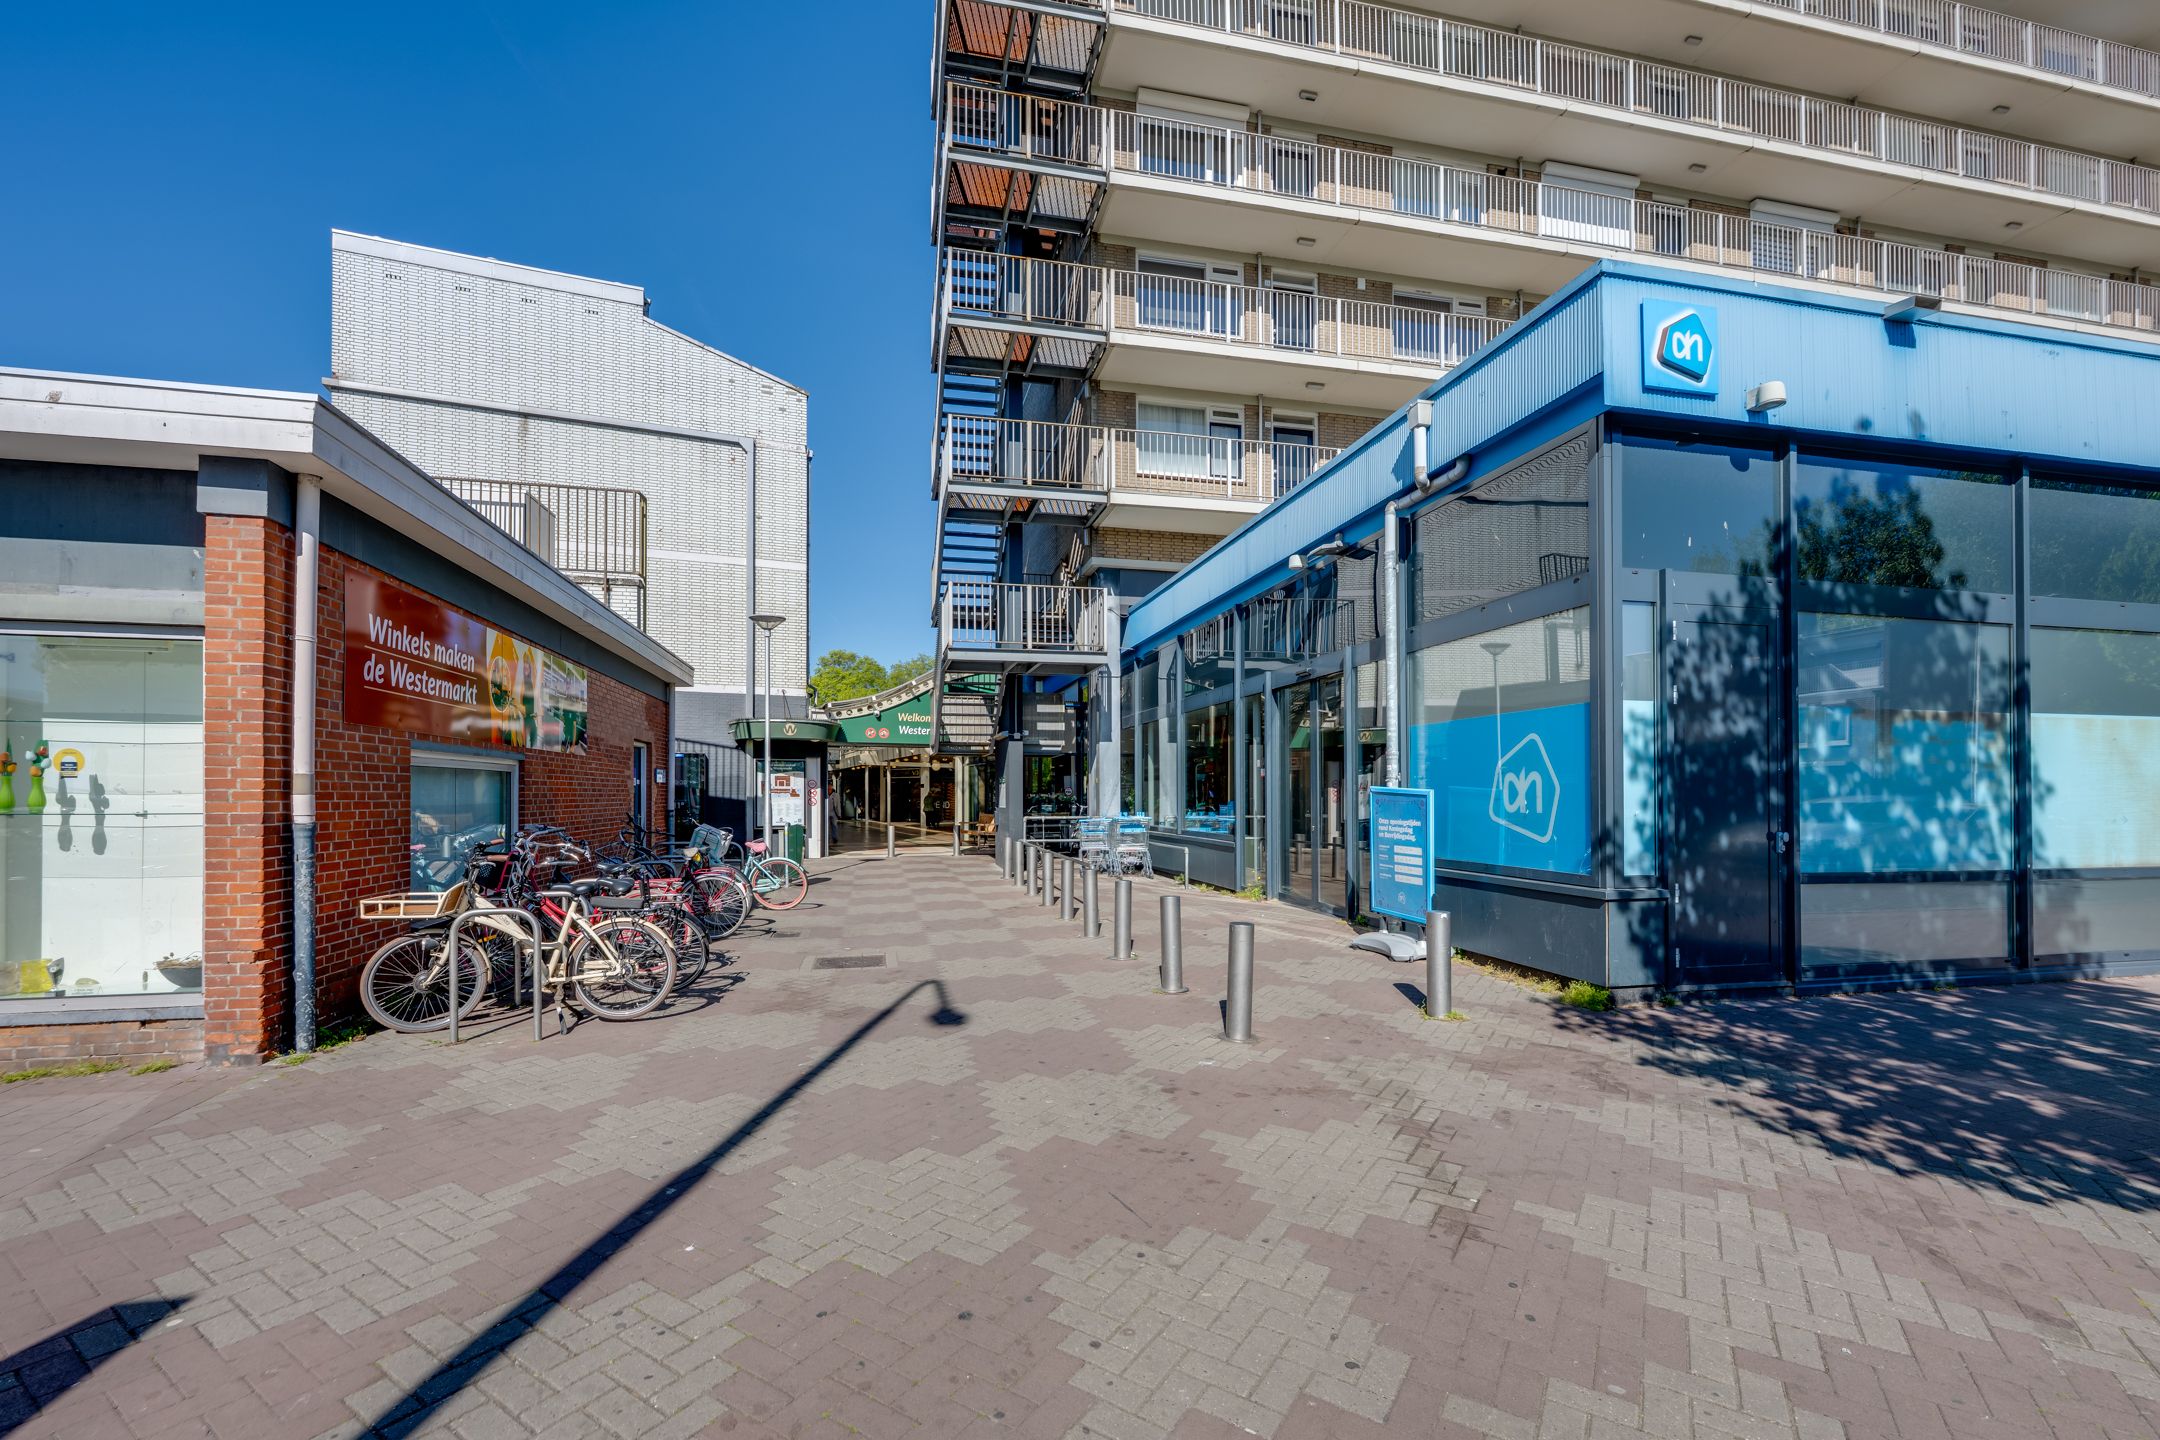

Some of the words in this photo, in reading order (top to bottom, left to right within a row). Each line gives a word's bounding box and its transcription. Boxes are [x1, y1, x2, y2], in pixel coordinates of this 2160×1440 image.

[368, 613, 430, 658] Winkels
[433, 643, 475, 673] maken
[363, 653, 385, 684] de
[389, 658, 477, 705] Westermarkt
